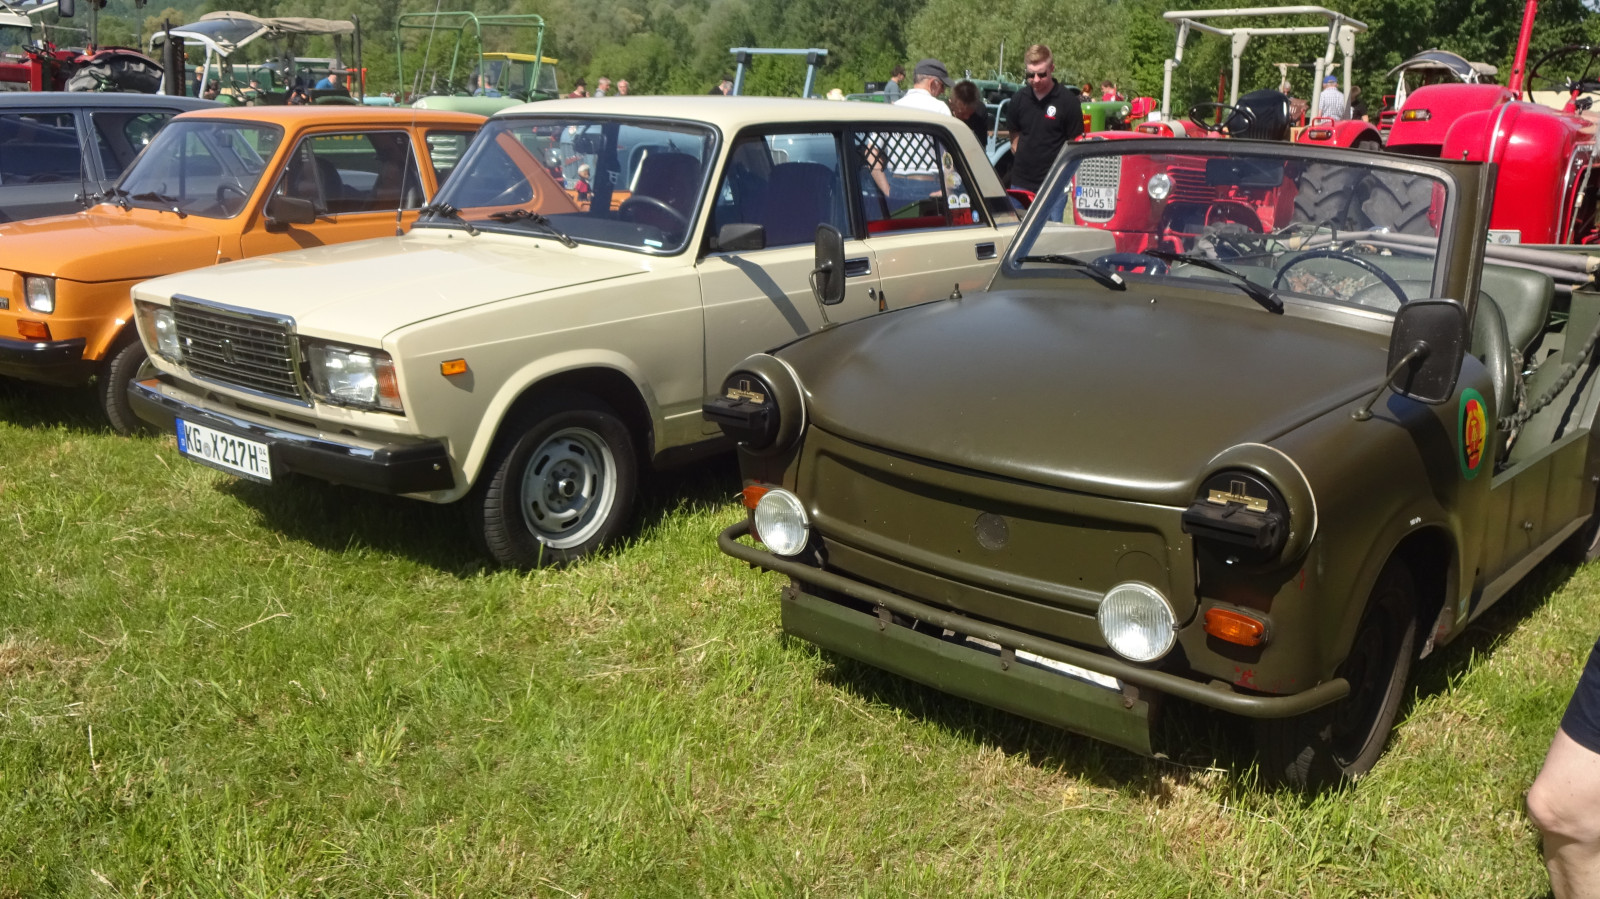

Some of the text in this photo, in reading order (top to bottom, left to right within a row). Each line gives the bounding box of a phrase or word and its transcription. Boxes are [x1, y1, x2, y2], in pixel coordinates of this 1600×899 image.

[1093, 199, 1105, 208] 45
[184, 424, 259, 472] KG X217H
